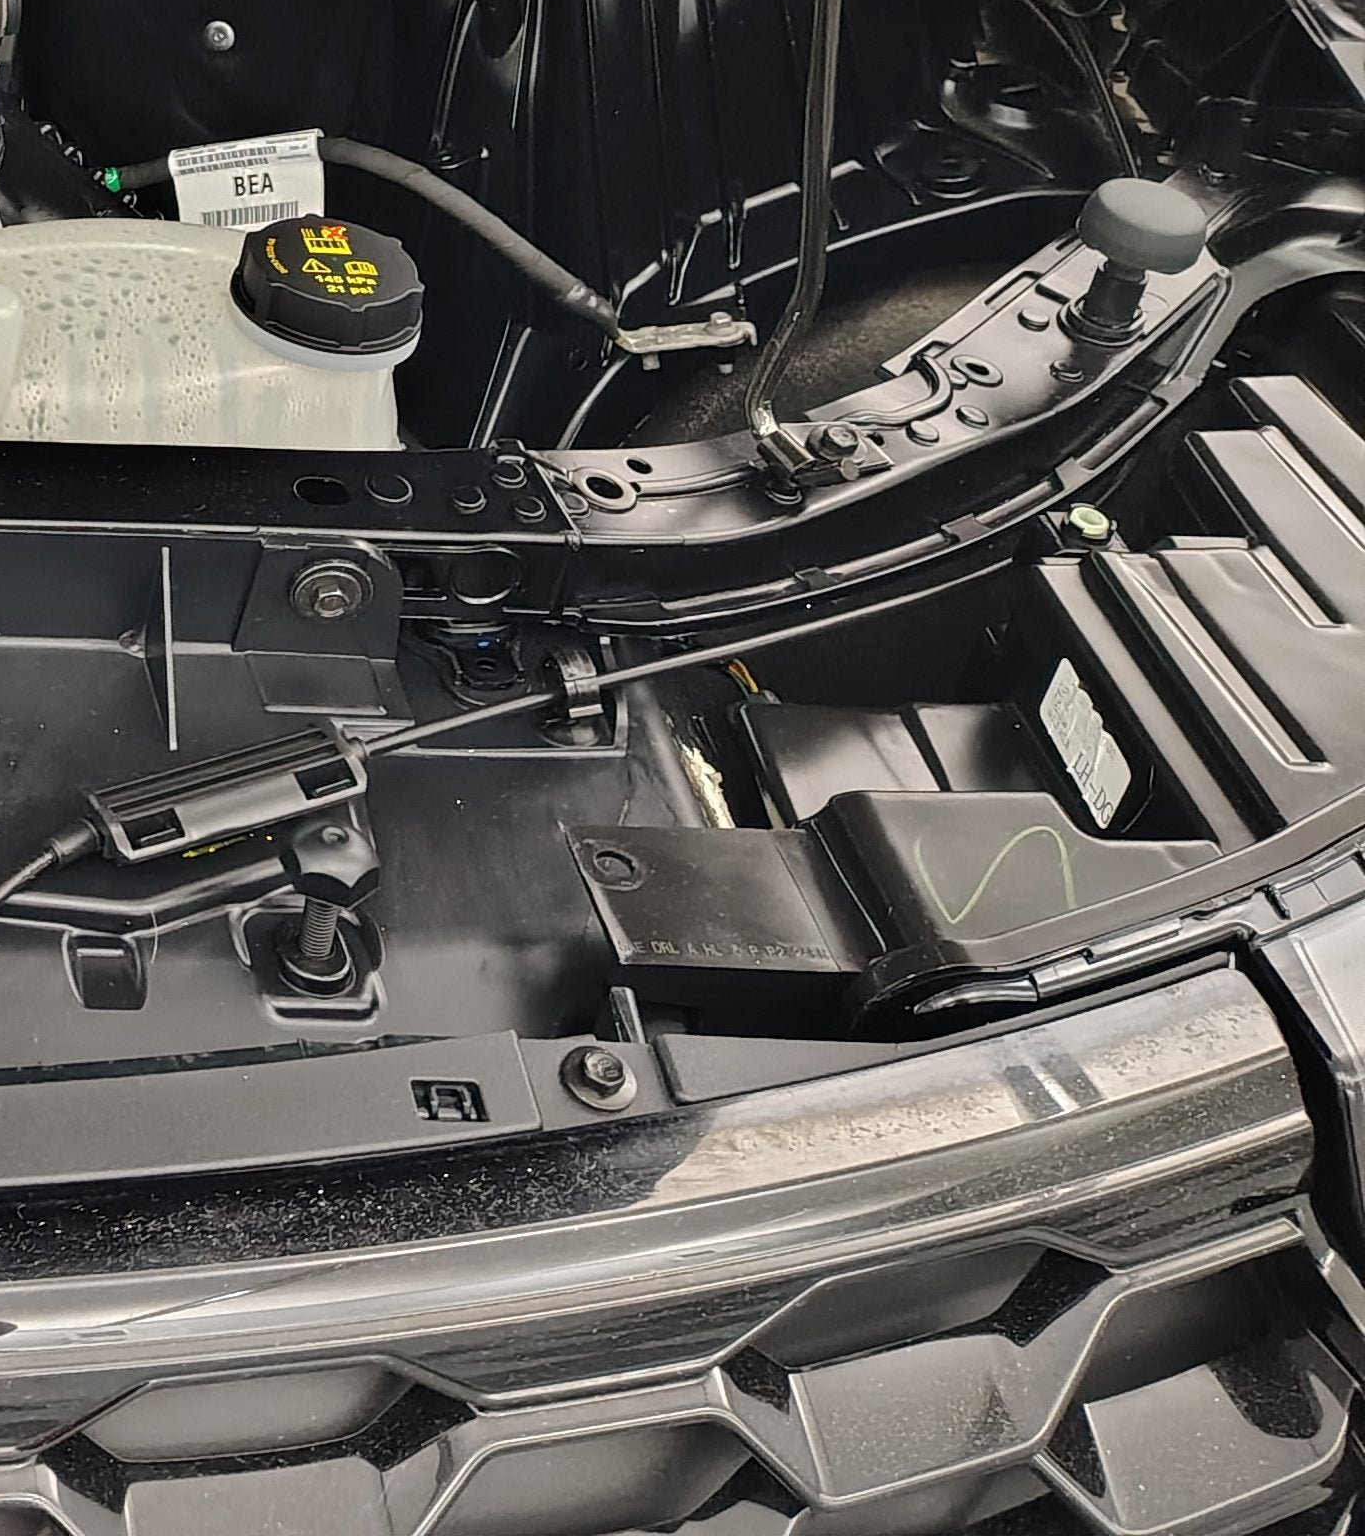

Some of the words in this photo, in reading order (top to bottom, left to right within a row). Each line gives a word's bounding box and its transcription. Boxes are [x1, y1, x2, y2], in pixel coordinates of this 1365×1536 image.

[234, 173, 274, 196] BEA
[347, 276, 377, 286] kPa
[326, 285, 346, 294] 21
[350, 286, 374, 295] psi
